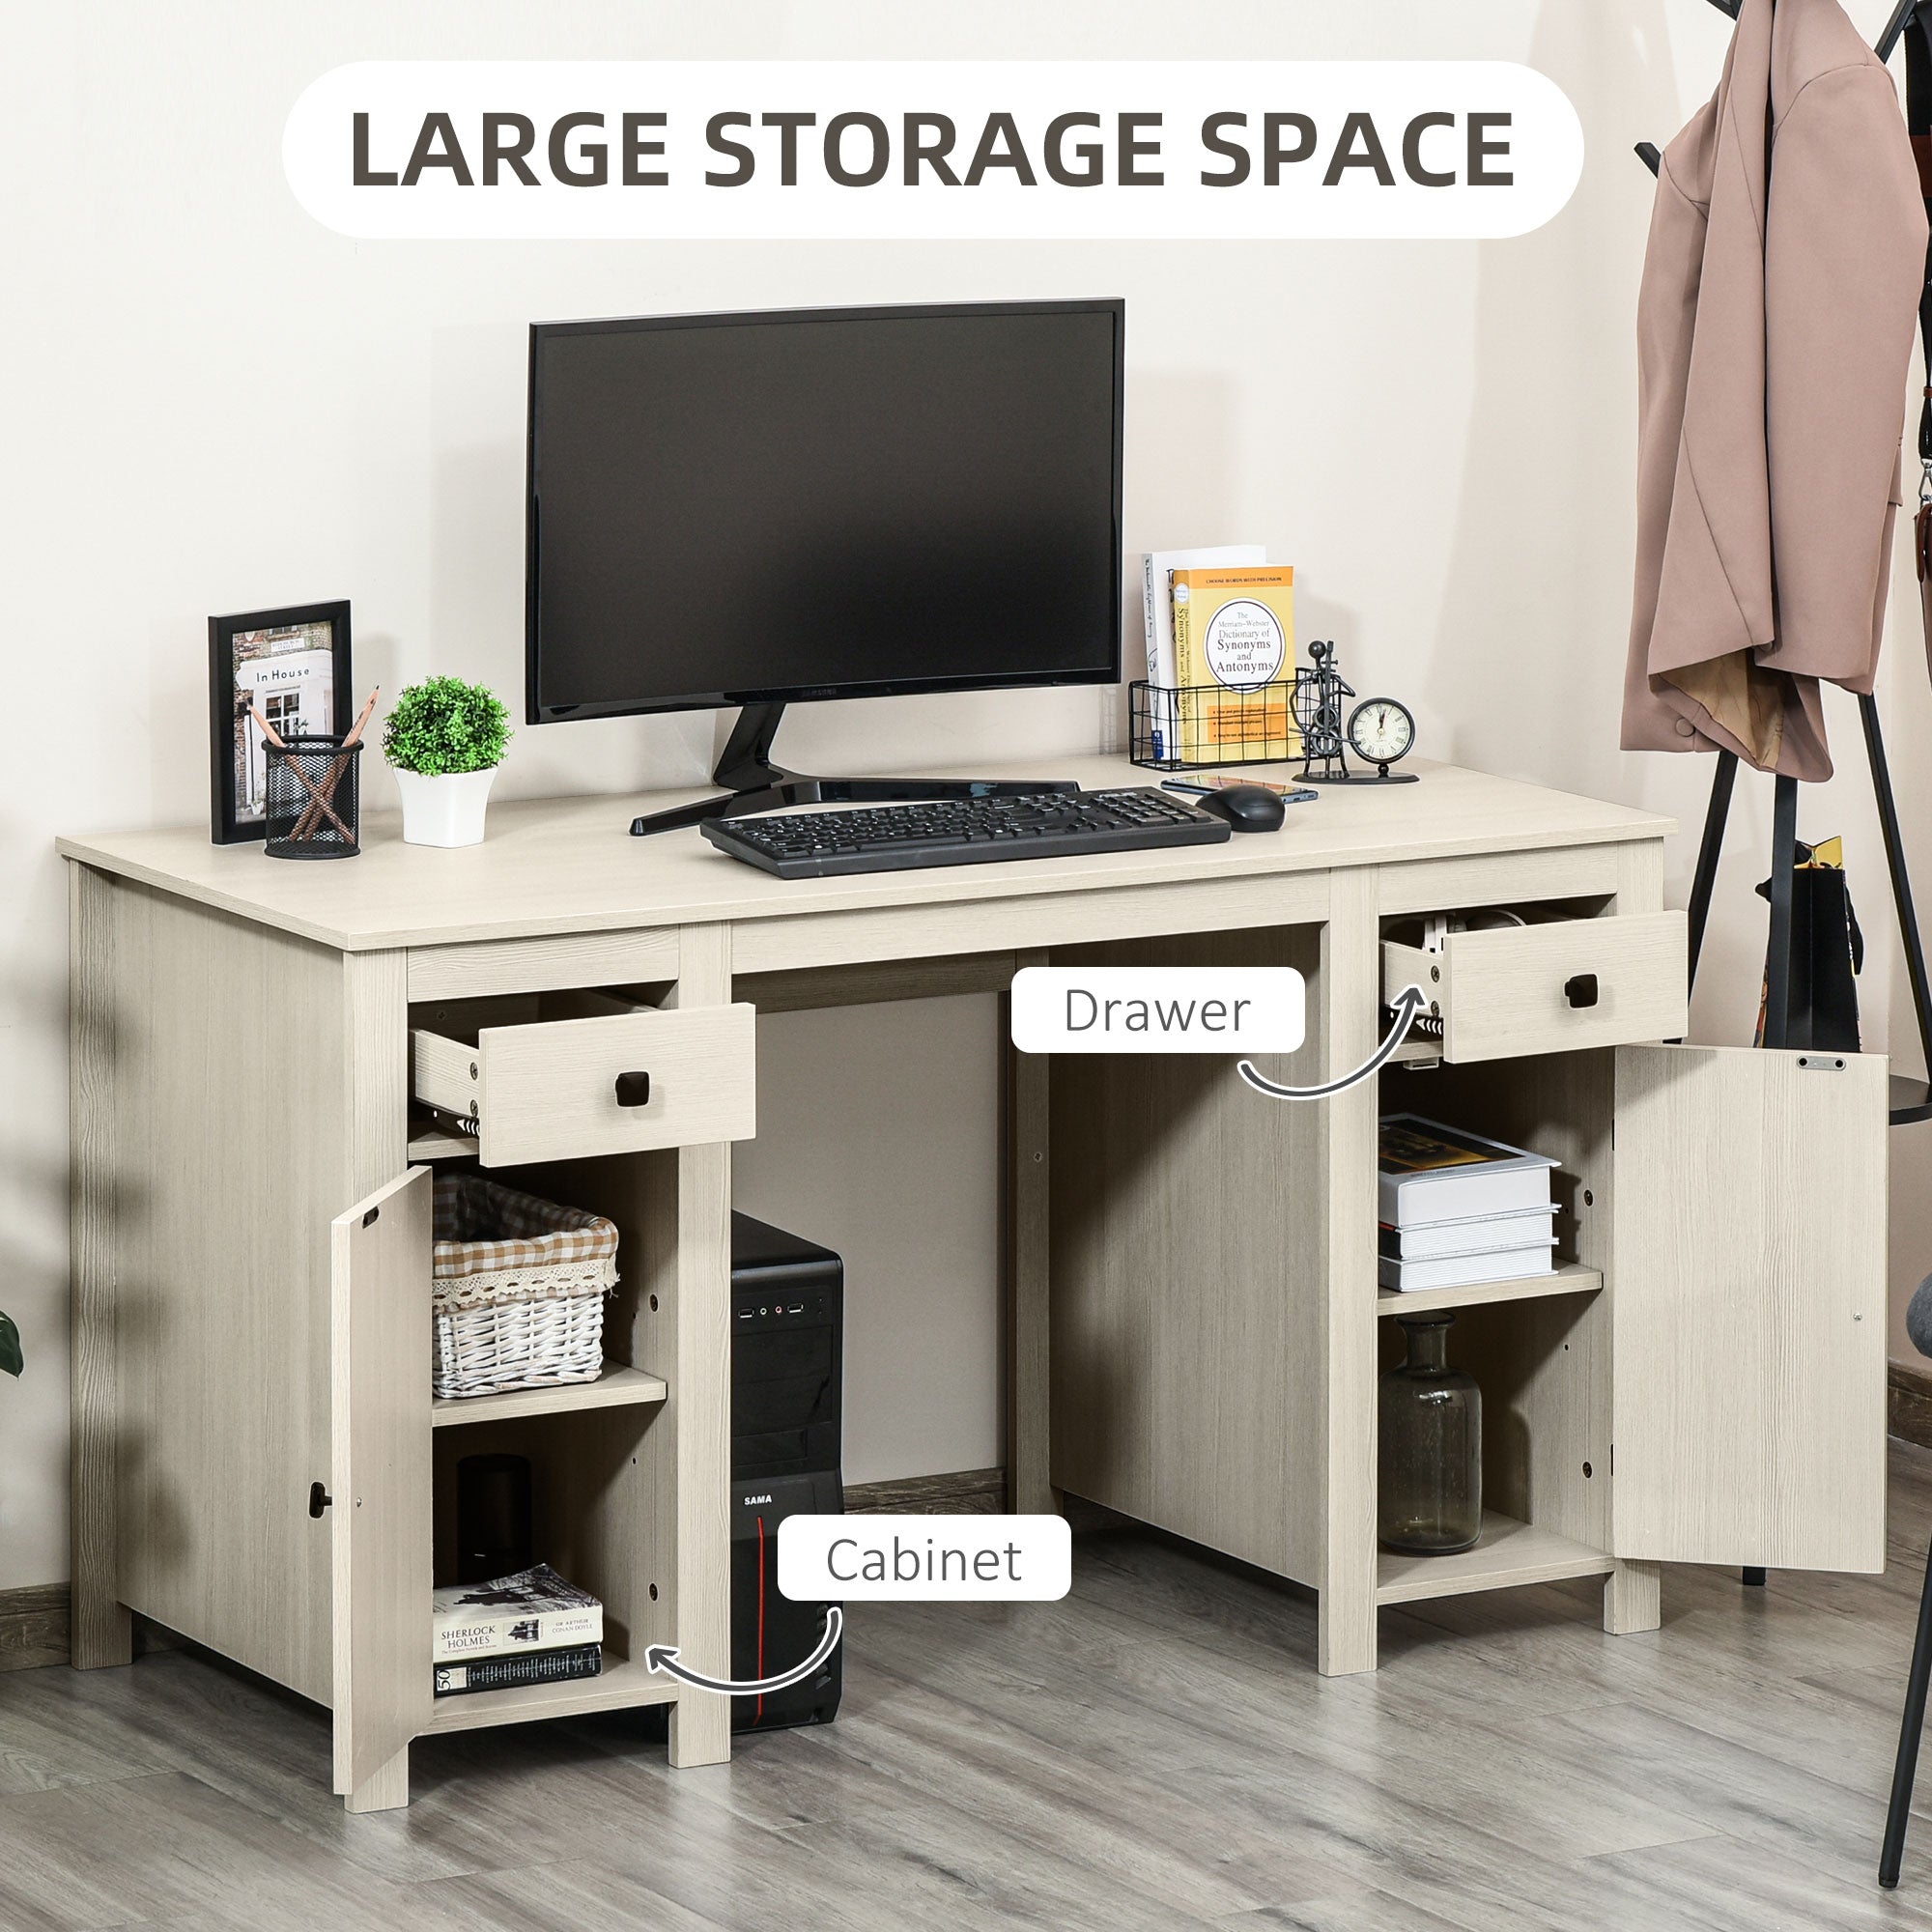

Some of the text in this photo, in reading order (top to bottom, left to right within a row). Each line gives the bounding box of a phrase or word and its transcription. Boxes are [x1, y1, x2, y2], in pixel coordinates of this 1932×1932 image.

[1177, 608, 1186, 658] Synonyms
[1218, 628, 1270, 639] Dictionary of
[1217, 639, 1271, 653] Synonyms
[1236, 652, 1252, 661] and
[1216, 662, 1274, 674] Antonyms
[256, 668, 309, 682] In House
[744, 1493, 772, 1506] SAMA
[441, 1625, 496, 1640] SHERLOCK
[447, 1635, 490, 1648] HOLMES
[438, 1670, 451, 1690] 50
